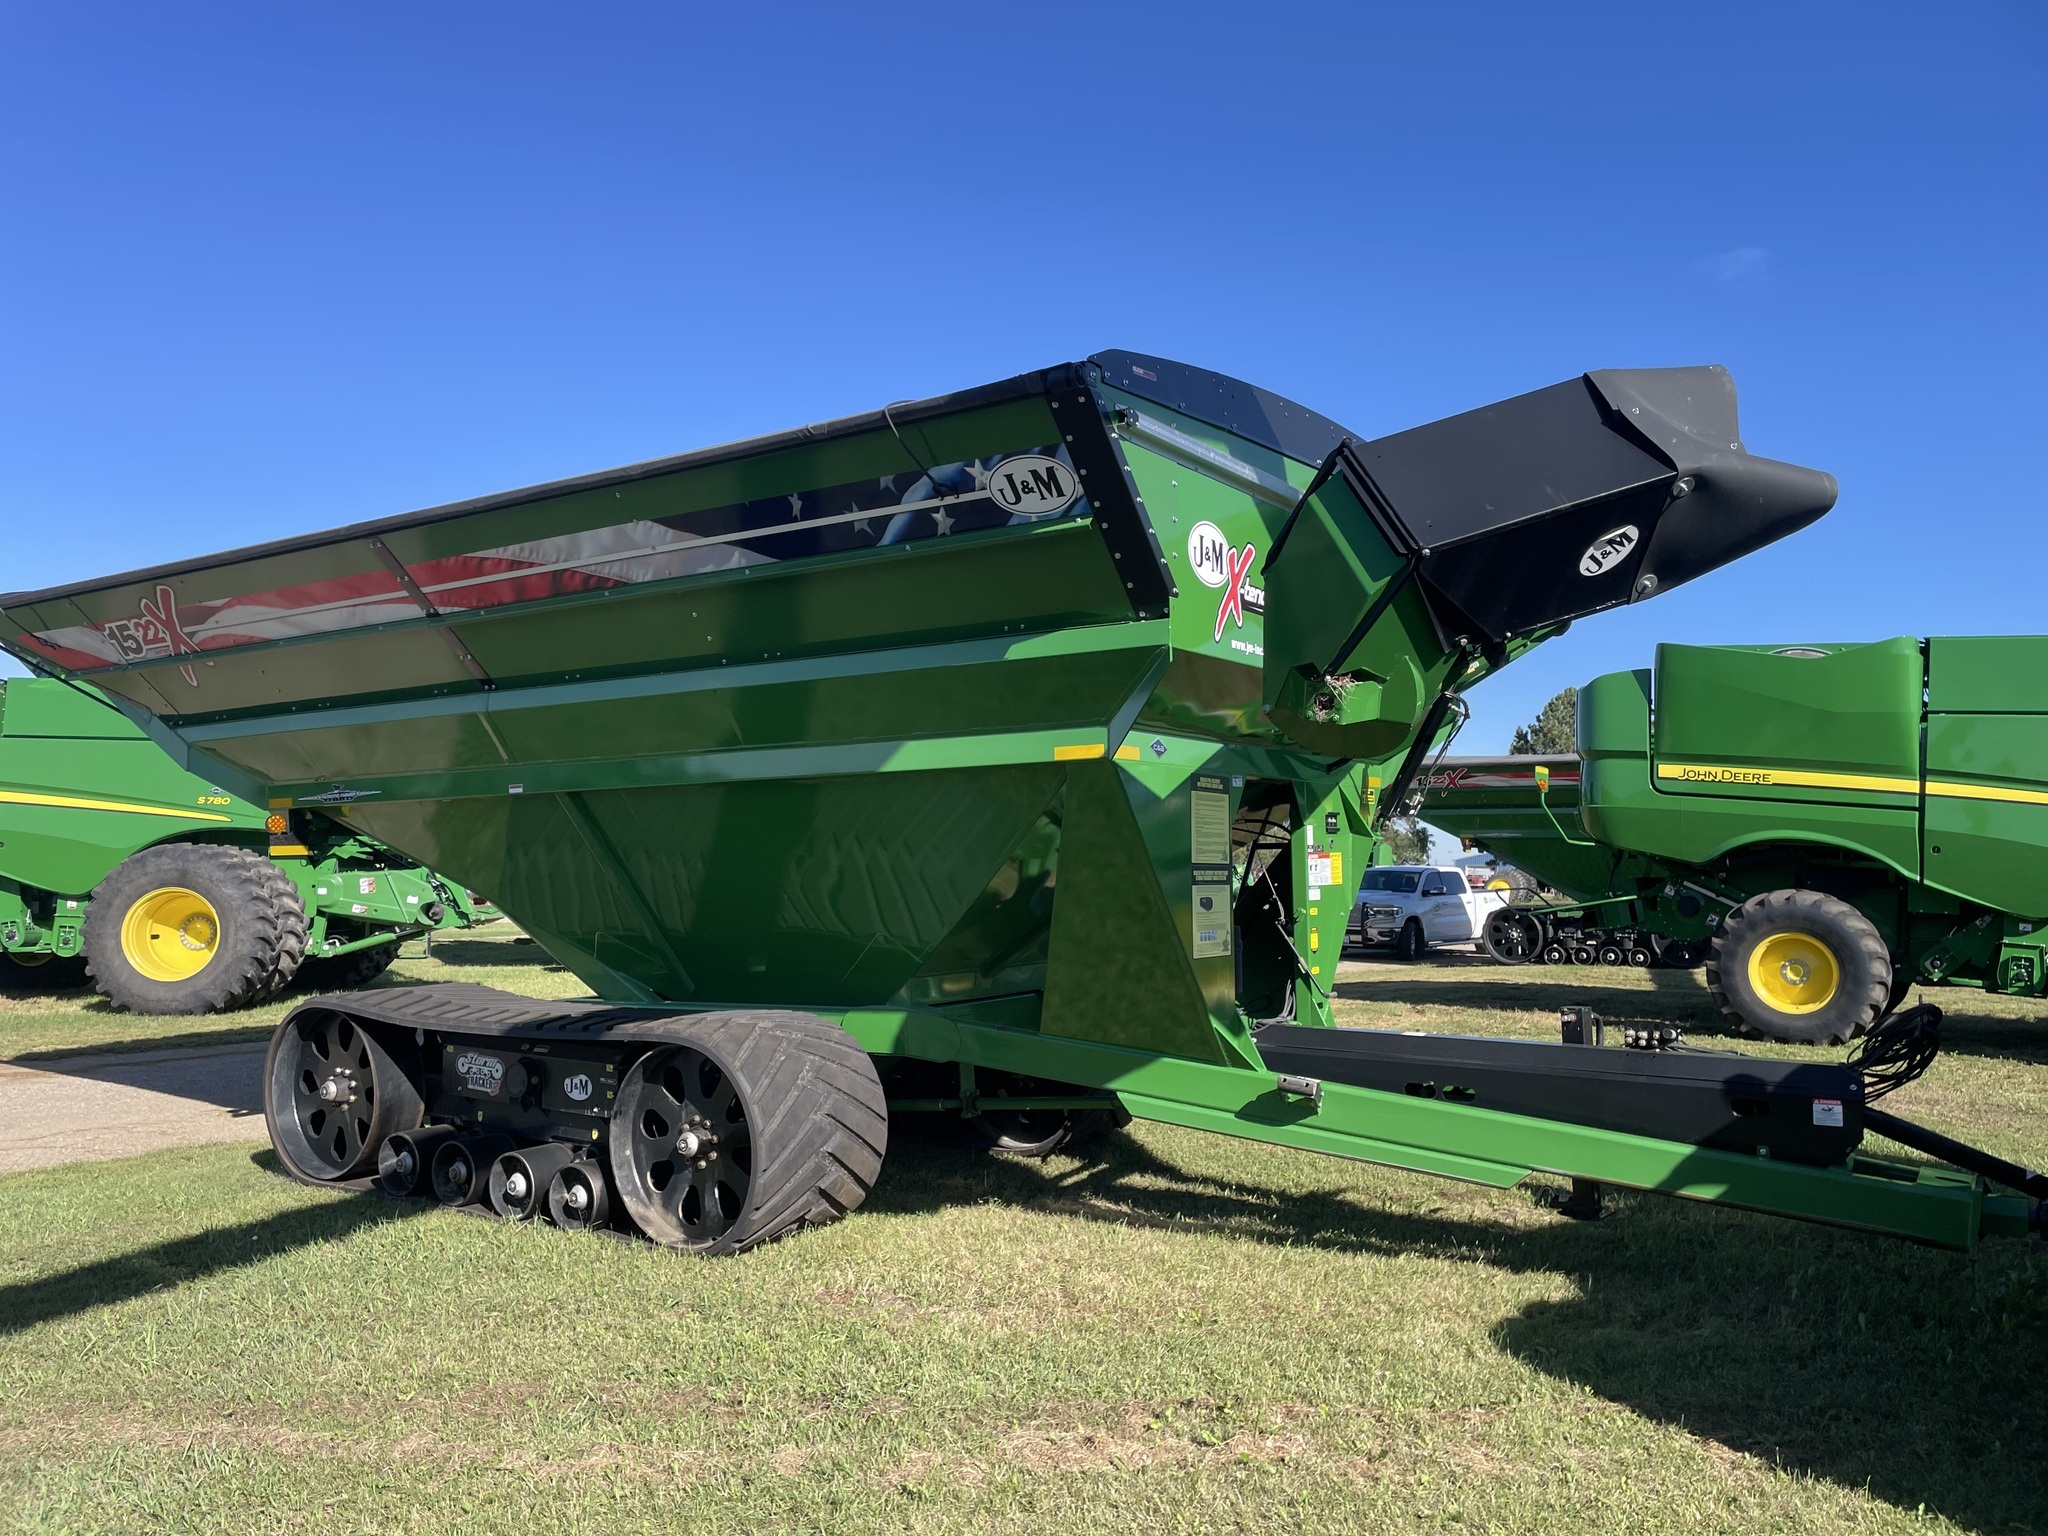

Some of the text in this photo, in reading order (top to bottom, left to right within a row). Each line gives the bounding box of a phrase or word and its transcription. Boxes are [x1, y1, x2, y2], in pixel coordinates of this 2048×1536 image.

[997, 466, 1067, 506] J&M
[1193, 534, 1224, 575] J&M
[1583, 531, 1636, 575] J&M
[1678, 768, 1772, 784] JOHN DEERE
[465, 1053, 498, 1068] Storm
[565, 1078, 589, 1096] J&M
